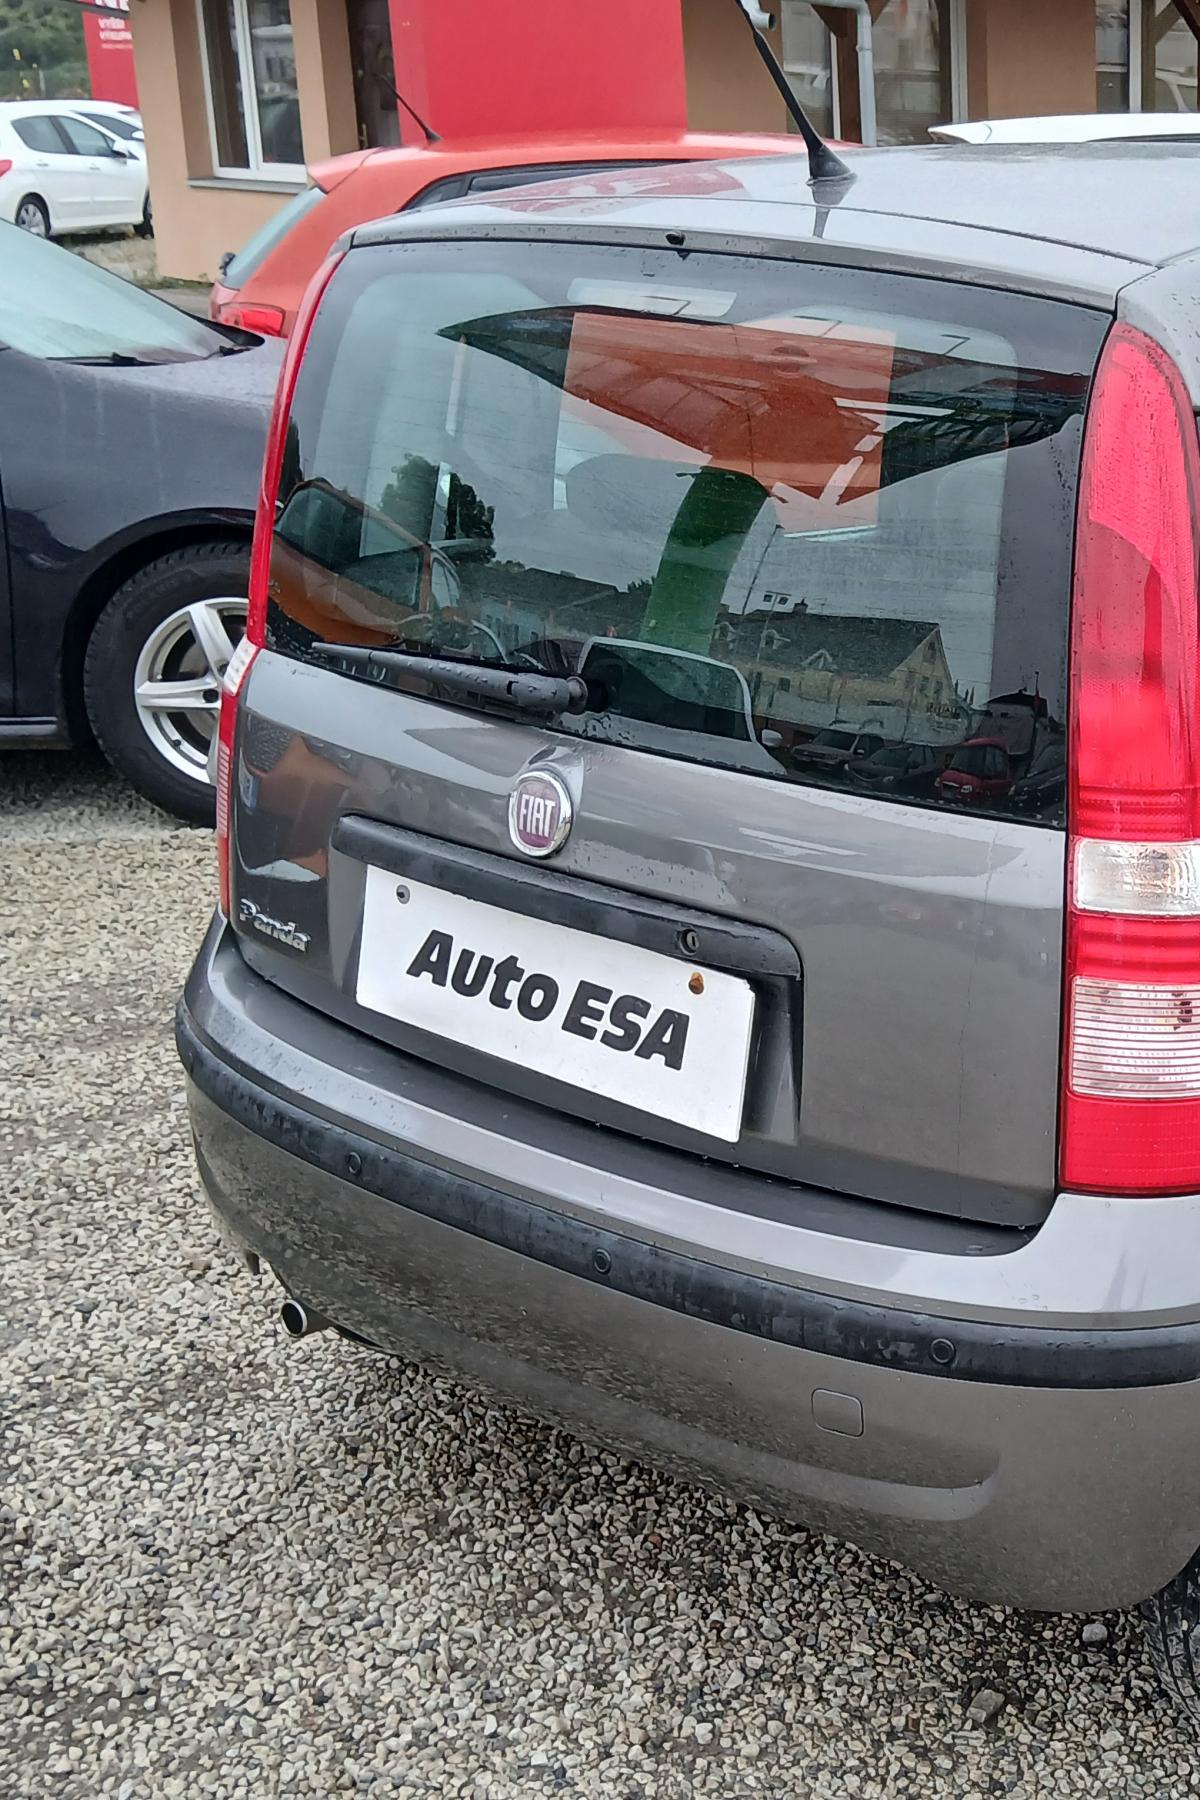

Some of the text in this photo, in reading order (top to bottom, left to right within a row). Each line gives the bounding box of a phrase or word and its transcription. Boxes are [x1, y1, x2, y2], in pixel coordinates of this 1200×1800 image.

[518, 793, 556, 838] FIAT
[239, 898, 311, 952] Panda
[405, 929, 690, 1071] Auto ESA
